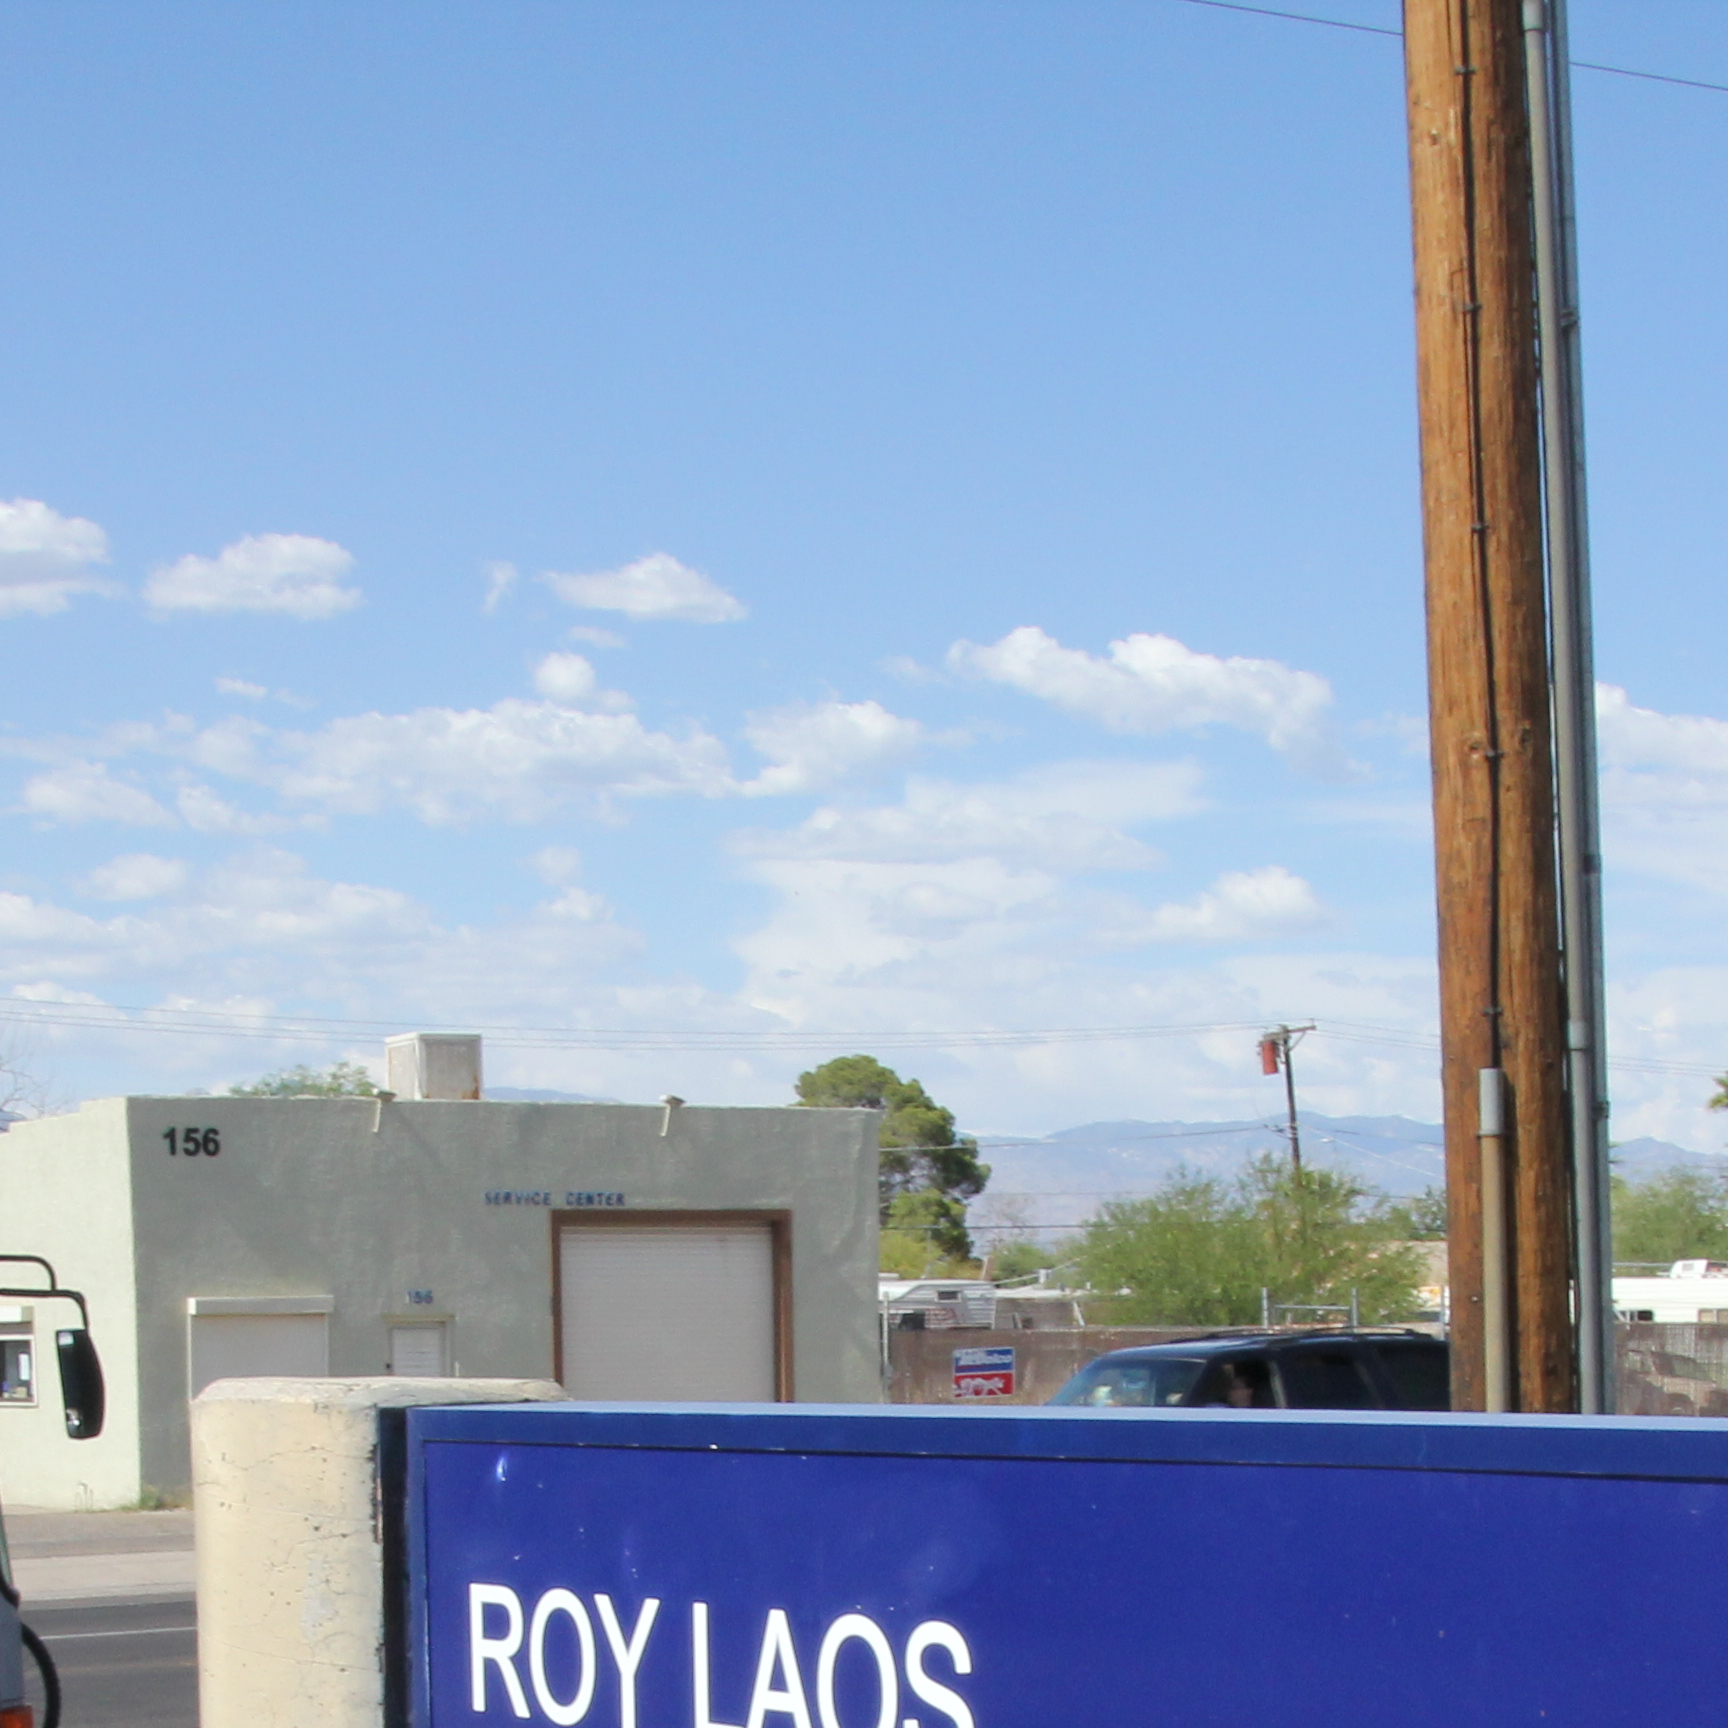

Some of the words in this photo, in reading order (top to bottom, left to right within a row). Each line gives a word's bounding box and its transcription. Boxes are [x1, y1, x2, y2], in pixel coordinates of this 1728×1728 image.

[162, 1127, 221, 1157] 156
[484, 1190, 551, 1206] SERVICE
[566, 1191, 625, 1206] CENTER
